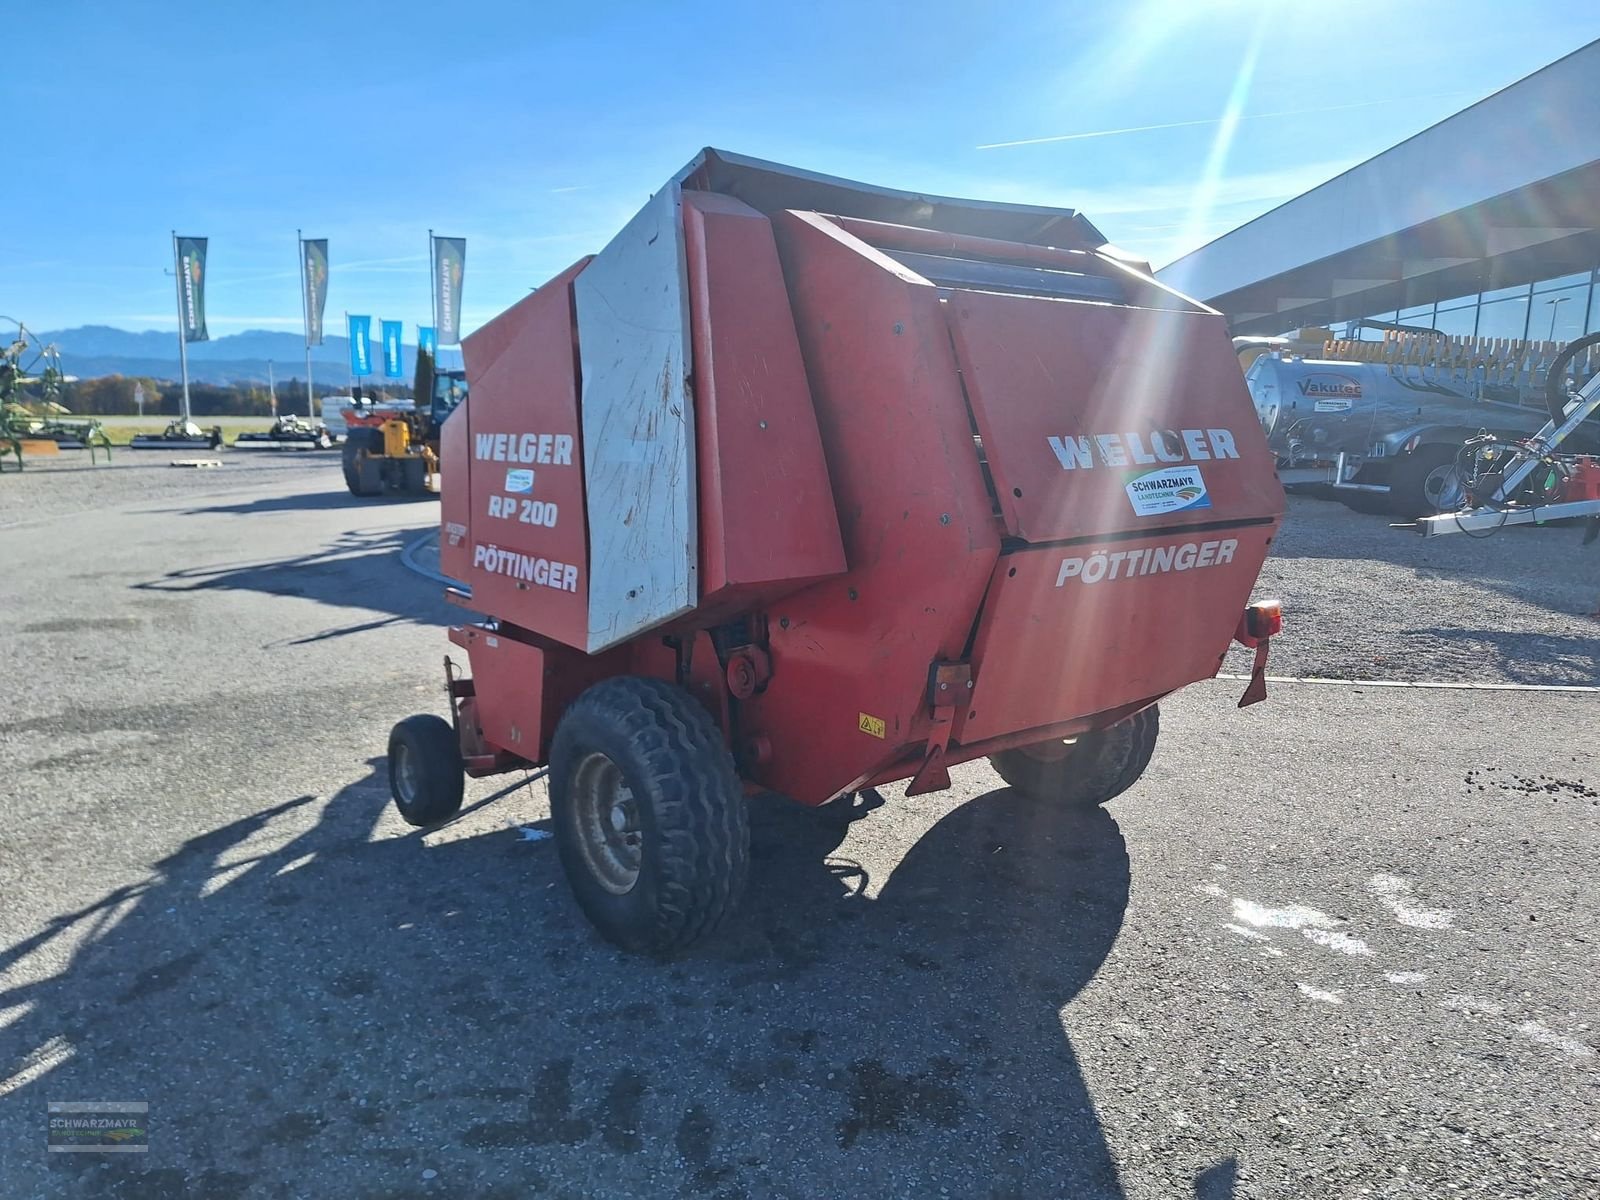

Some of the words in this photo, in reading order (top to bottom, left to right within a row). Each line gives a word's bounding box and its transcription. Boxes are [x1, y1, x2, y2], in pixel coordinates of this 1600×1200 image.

[1296, 378, 1362, 396] Vakutec
[475, 433, 574, 465] WELGER
[1131, 477, 1194, 492] SCHWARZMAYR
[488, 495, 517, 519] RP
[519, 500, 558, 528] 200
[473, 544, 578, 593] PÖTTINGER
[1055, 538, 1238, 587] PÖTTINGER
